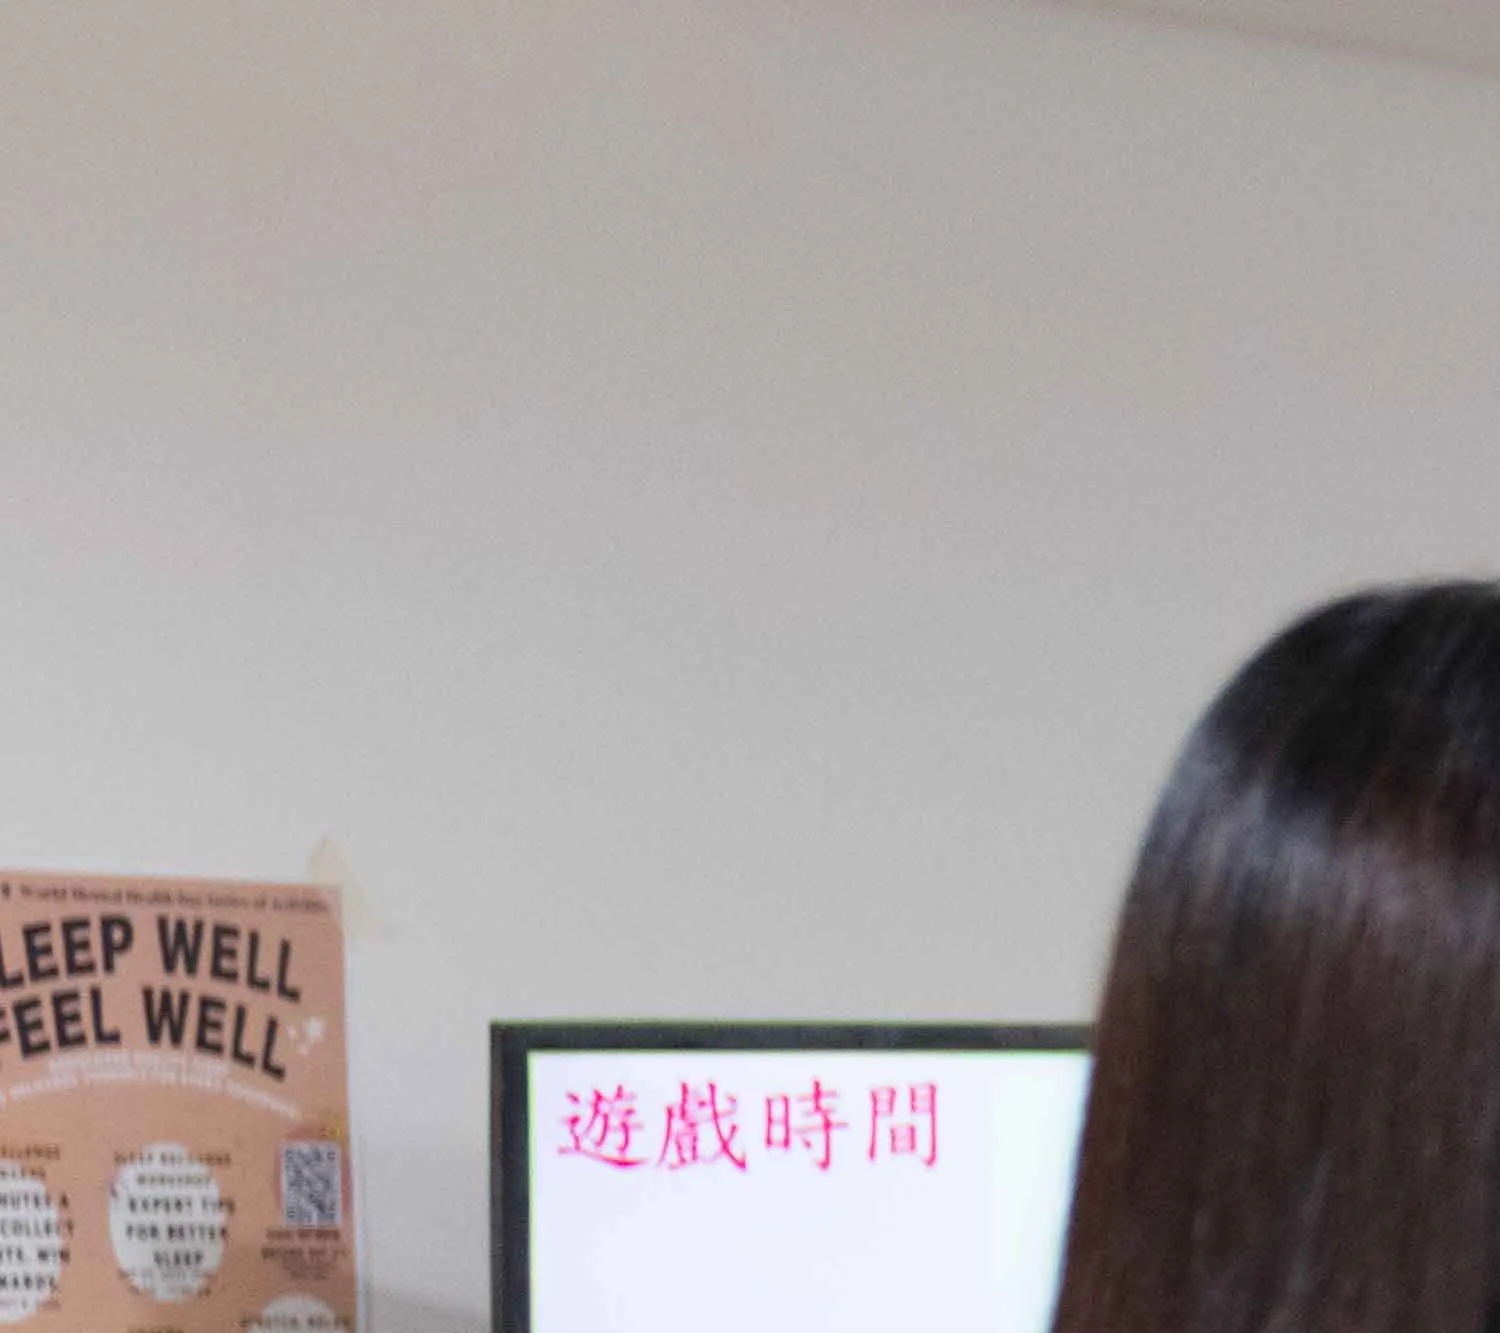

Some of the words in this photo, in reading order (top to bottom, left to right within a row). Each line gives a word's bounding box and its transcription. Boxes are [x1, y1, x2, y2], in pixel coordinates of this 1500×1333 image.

[156, 914, 302, 1003] WELL
[141, 984, 286, 1083] WELL
[557, 1078, 938, 1172] 遊戲時間
